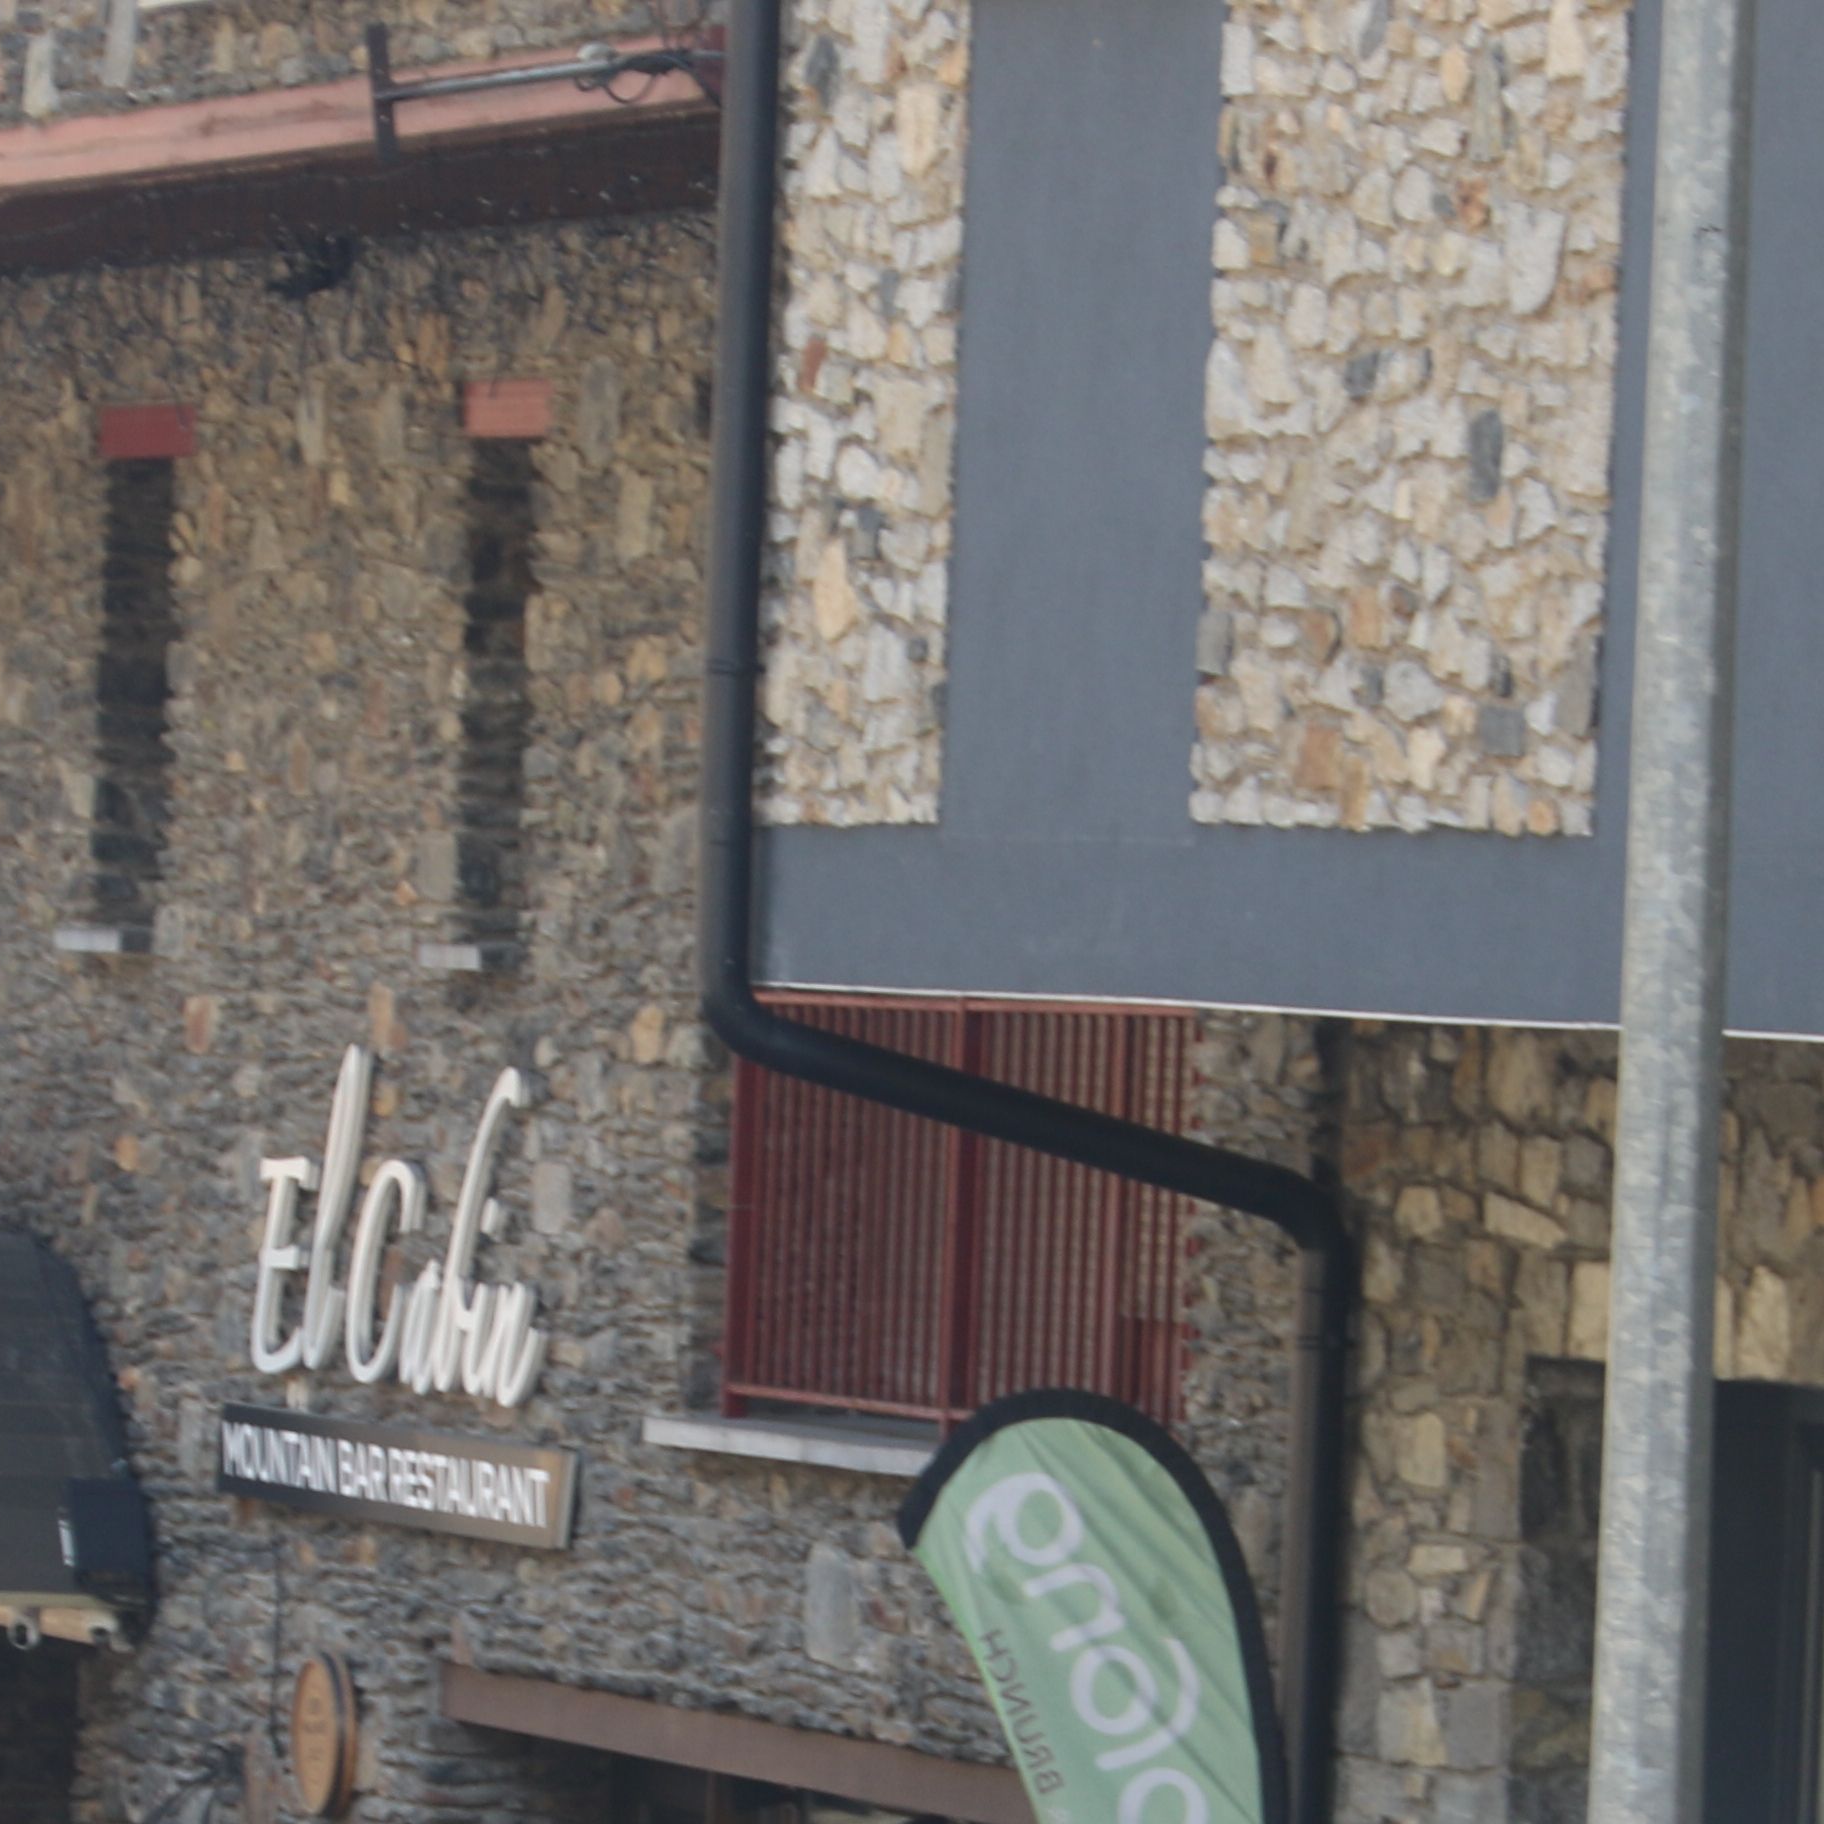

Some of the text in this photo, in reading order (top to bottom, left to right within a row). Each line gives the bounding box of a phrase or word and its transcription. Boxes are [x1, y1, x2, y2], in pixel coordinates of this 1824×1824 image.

[251, 1044, 374, 1375] El
[222, 1420, 551, 1528] MOUNTAIN BAR RESTAURANT
